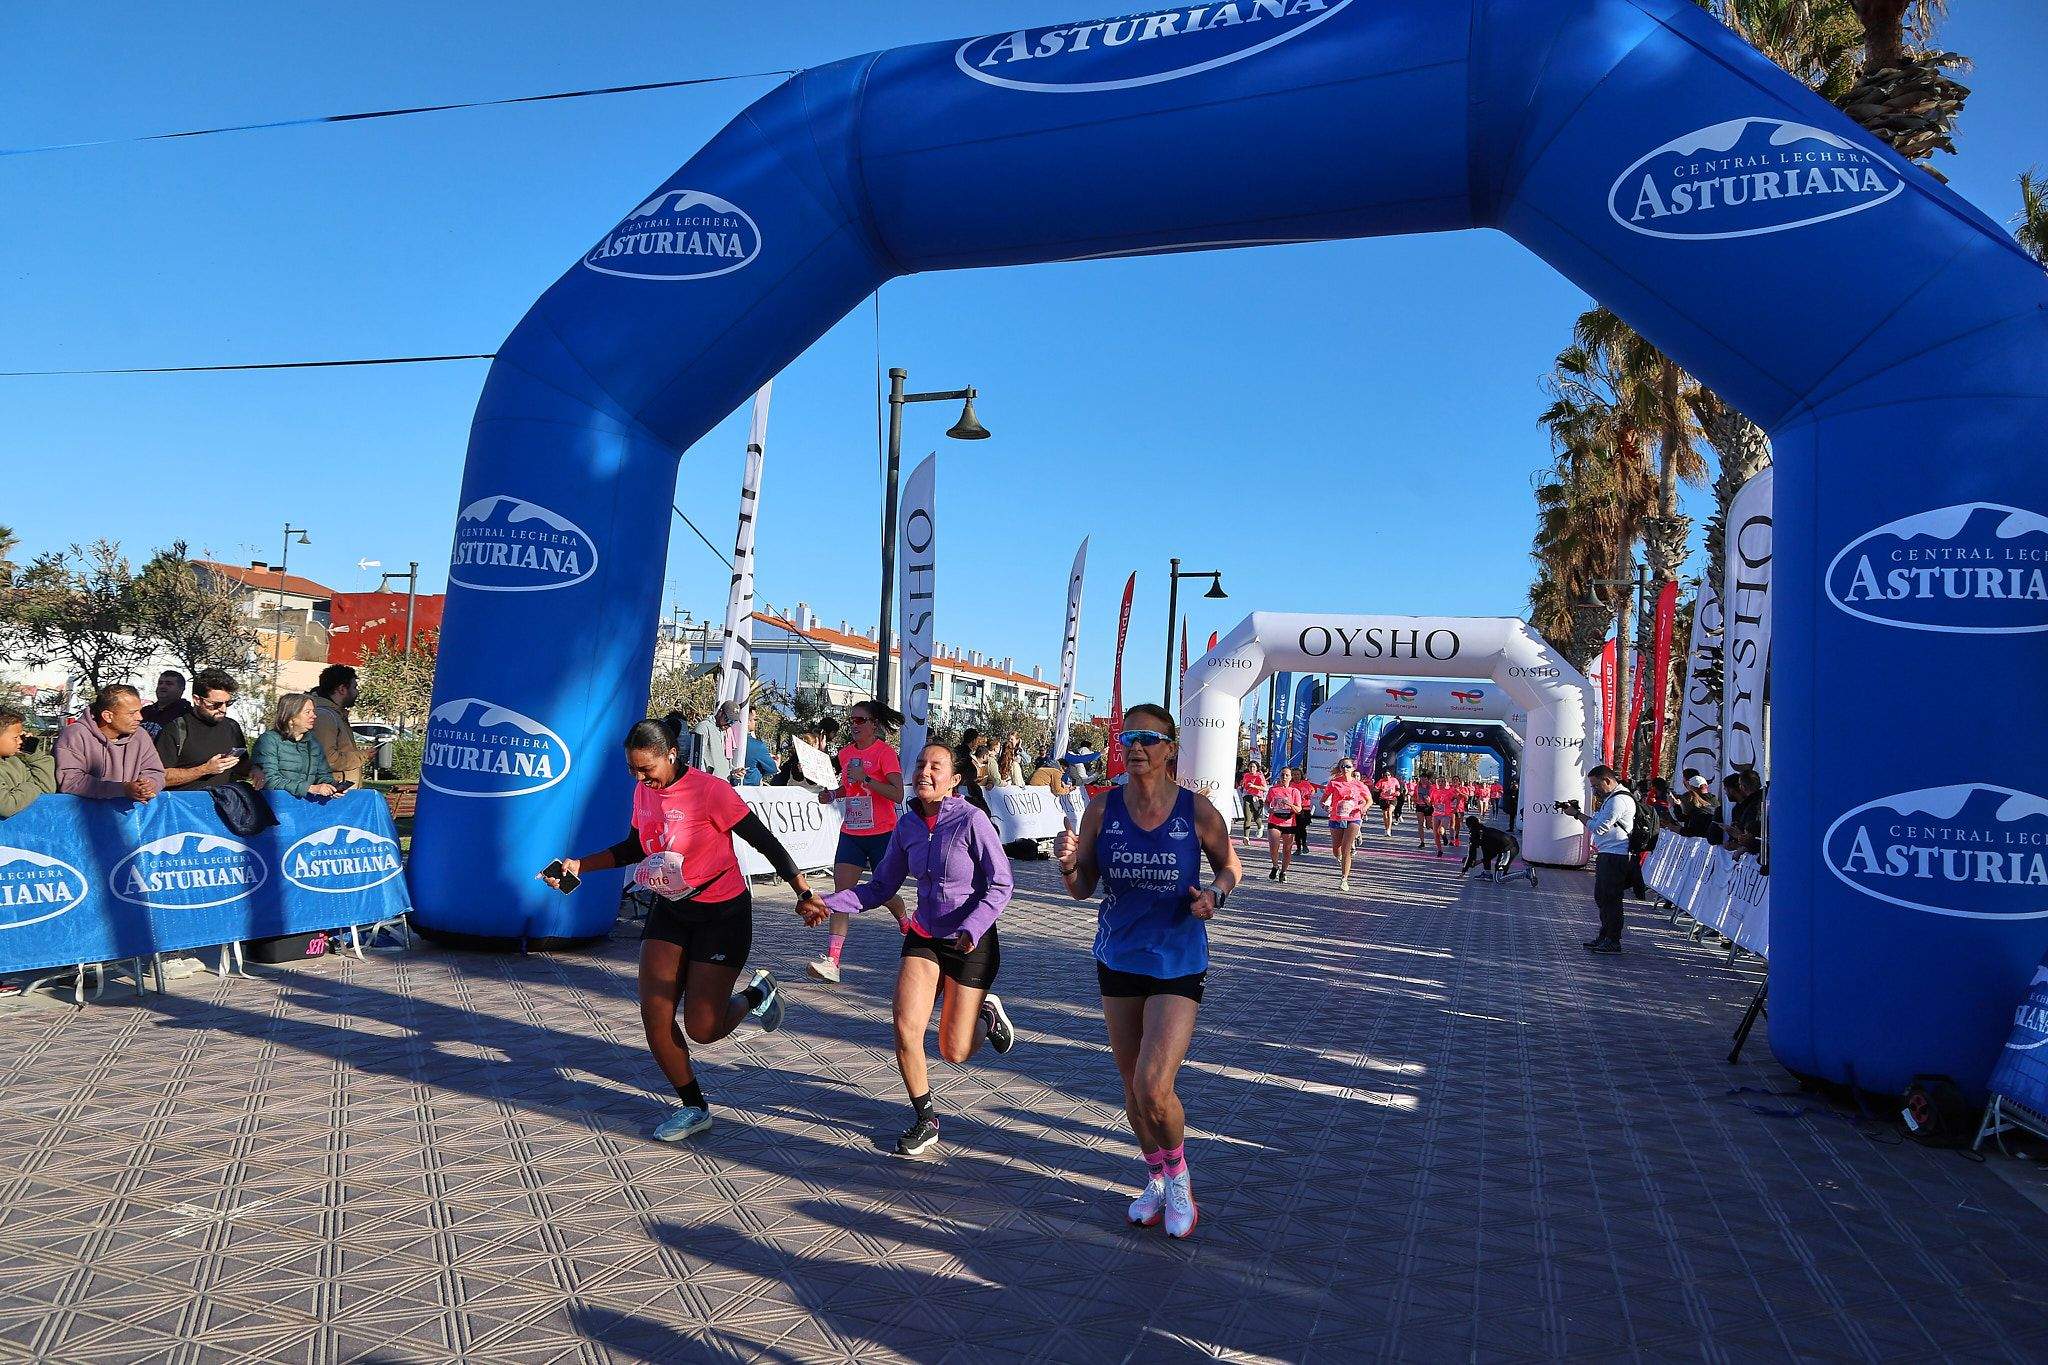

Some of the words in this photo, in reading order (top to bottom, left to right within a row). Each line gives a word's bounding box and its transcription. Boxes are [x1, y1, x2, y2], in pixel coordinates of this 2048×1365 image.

[1674, 154, 1771, 178] CENTRAL
[1780, 150, 1871, 164] LECHERA
[1630, 167, 1888, 222] ASTURIANA
[622, 218, 670, 233] CENTRAL
[676, 217, 739, 228] LECHERA
[590, 231, 745, 261] ASTURIANA
[461, 527, 505, 537] CENTRAL
[511, 529, 577, 546] LECHERA
[1891, 548, 1994, 562] CENTRAL
[1298, 626, 1460, 661] OYSHO
[1207, 657, 1252, 669] OYSHO
[1508, 666, 1560, 678] OYSHO
[1184, 717, 1225, 729] OYSHO
[433, 728, 476, 742] CENTRAL
[482, 733, 550, 749] LECHERA
[1416, 728, 1484, 738] VOLVO
[1535, 736, 1584, 748] OYSHO
[1889, 825, 1994, 842] CENTRAL
[150, 858, 199, 869] CENTRAL
[295, 853, 399, 878] ASTURIANA
[1112, 852, 1177, 865] POBLATS
[123, 865, 258, 895] ASTURIANA
[1109, 866, 1179, 881] MARÍTIMS
